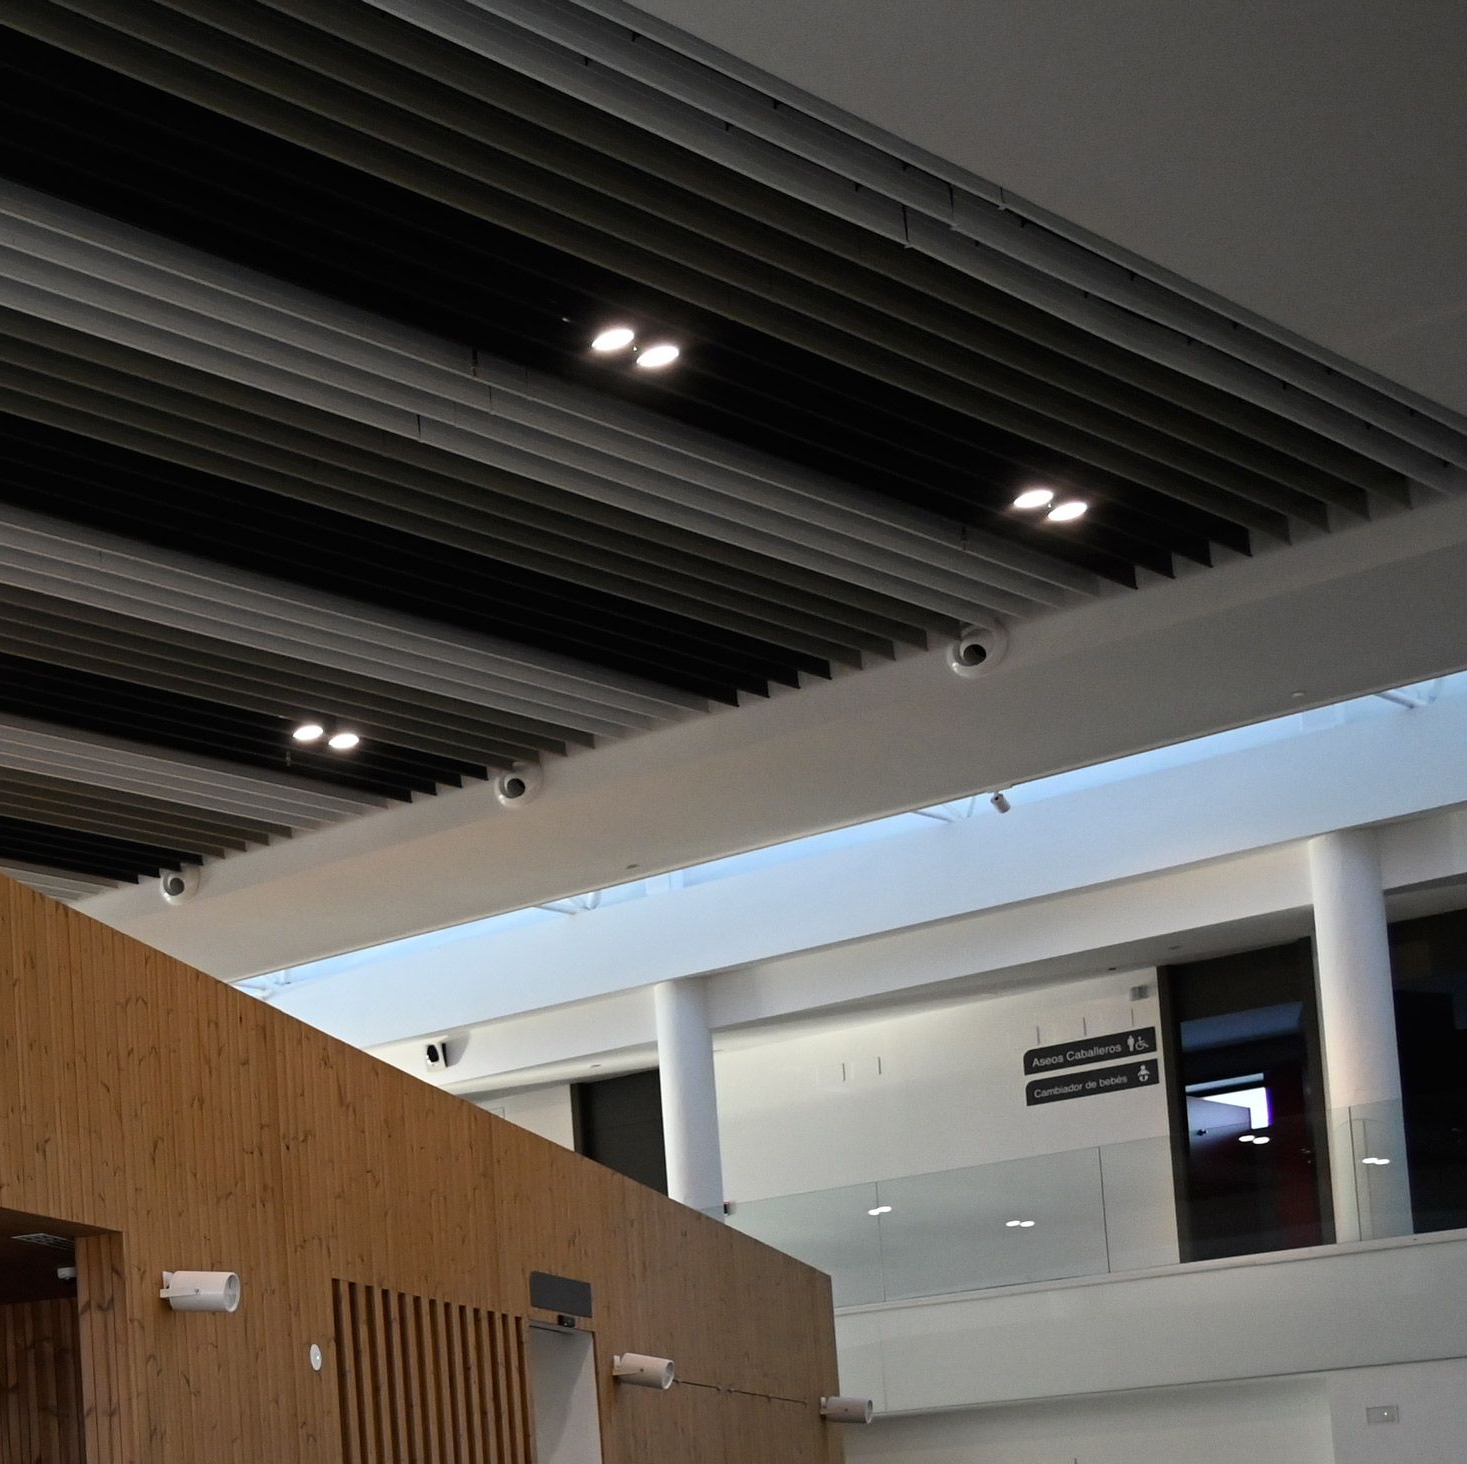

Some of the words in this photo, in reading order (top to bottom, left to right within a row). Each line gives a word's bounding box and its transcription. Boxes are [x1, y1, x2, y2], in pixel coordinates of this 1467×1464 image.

[1032, 1054, 1064, 1067] Aseos
[1066, 1043, 1122, 1061] Caballeros
[1034, 1082, 1083, 1098] Cambiador
[1085, 1078, 1097, 1090] de
[1099, 1074, 1128, 1088] bebés
